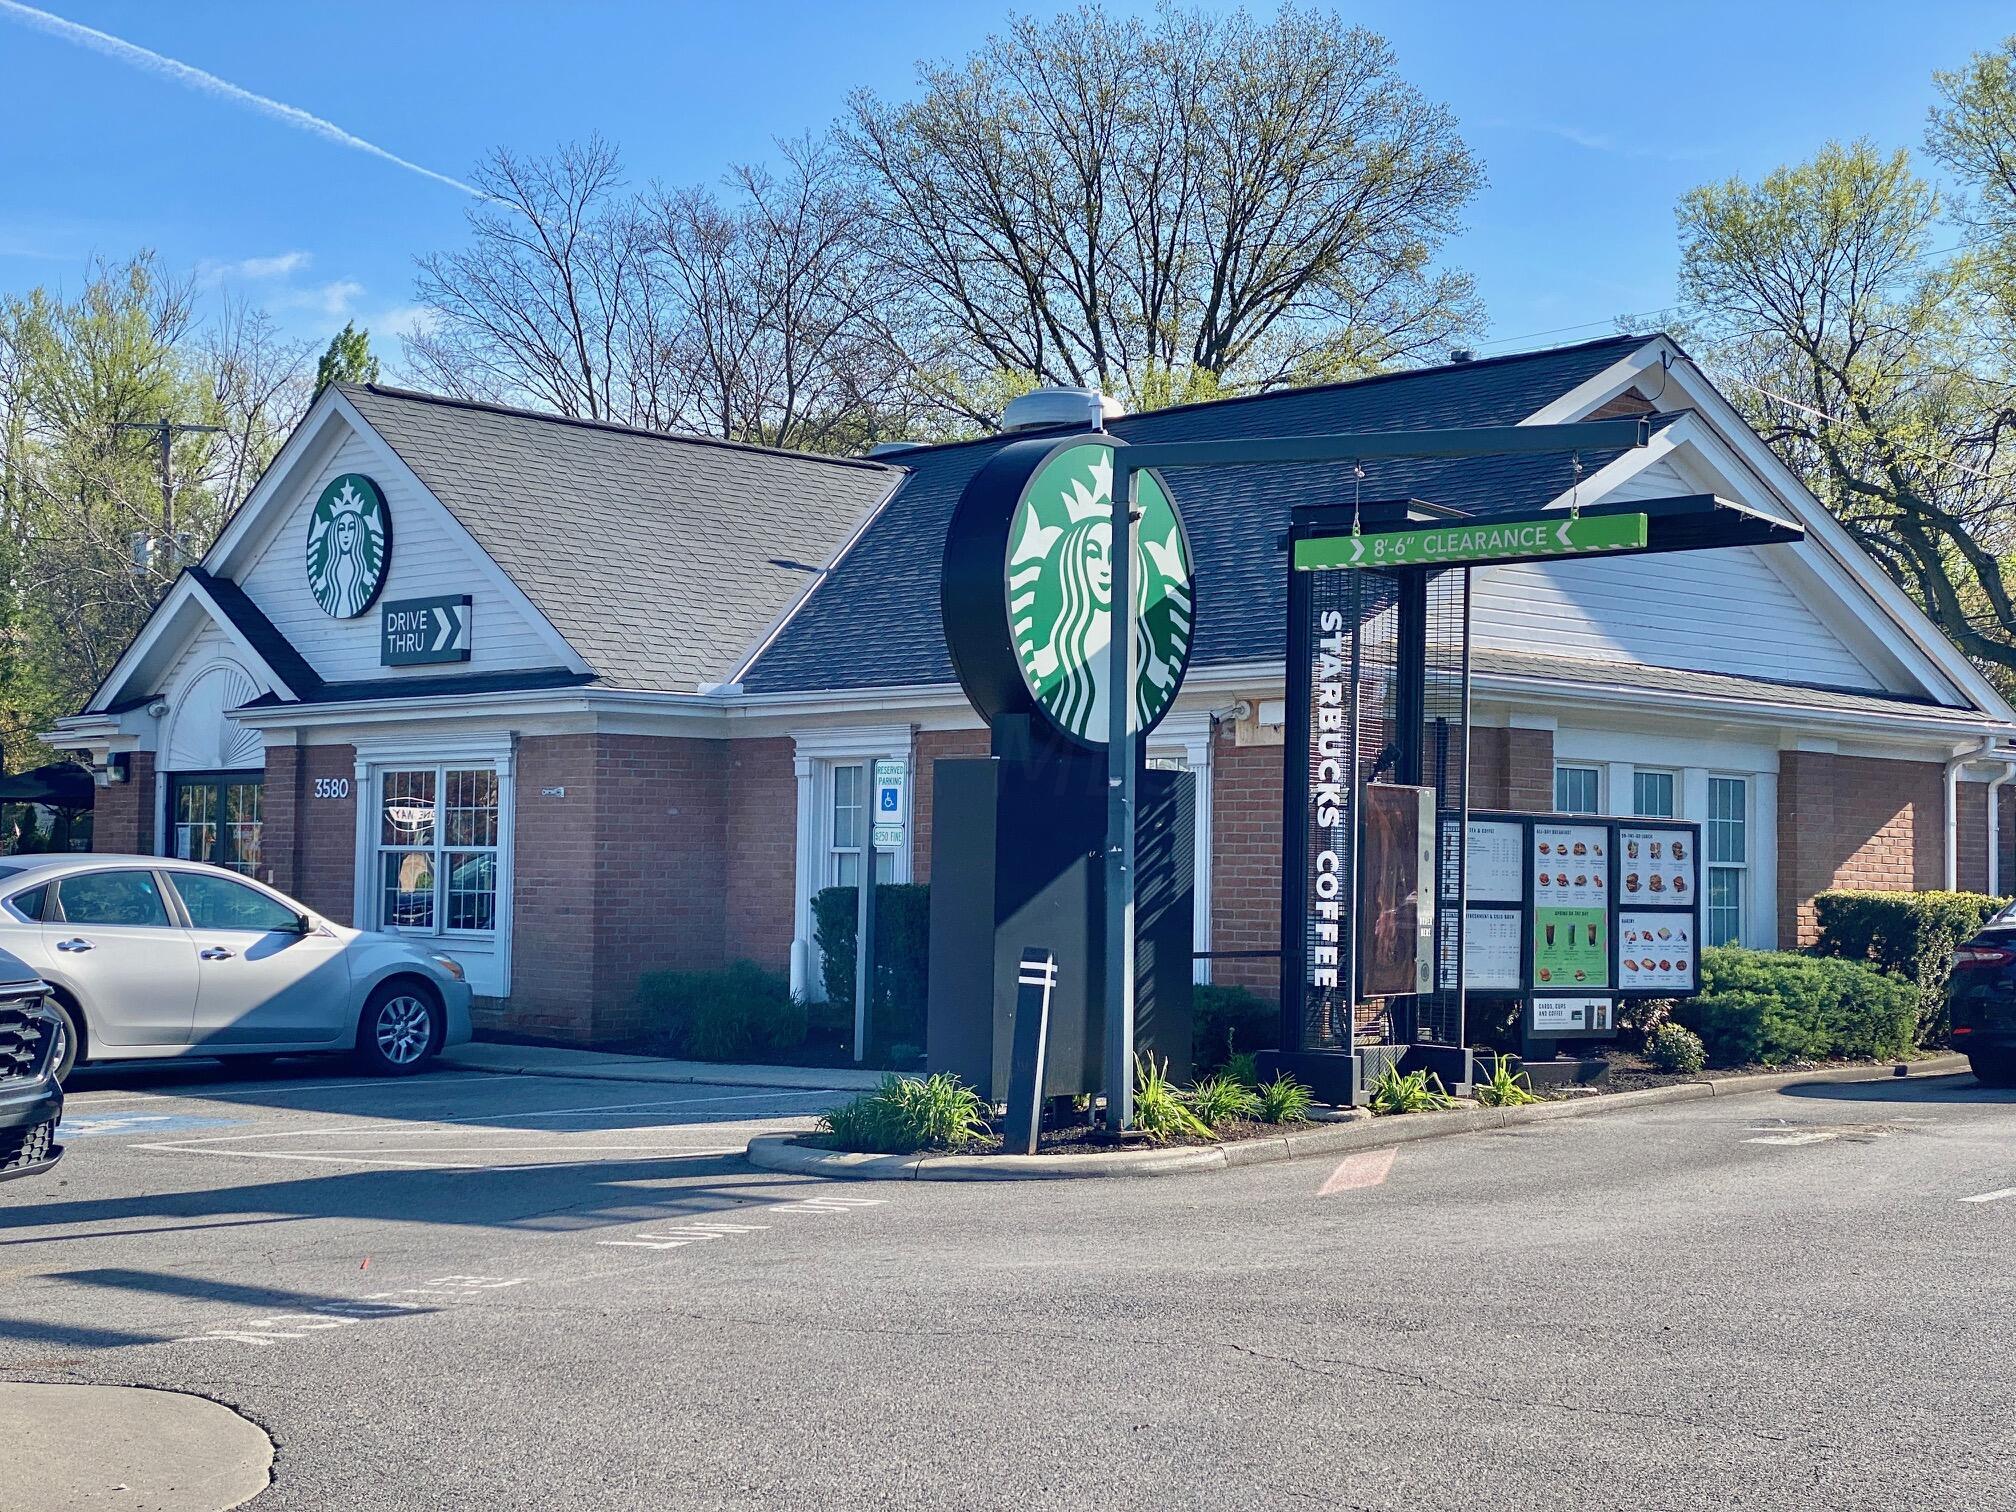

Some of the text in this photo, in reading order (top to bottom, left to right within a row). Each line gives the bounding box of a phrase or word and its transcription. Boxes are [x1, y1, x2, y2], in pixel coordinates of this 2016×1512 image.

[1423, 527, 1548, 555] CLEARANCE
[387, 609, 428, 633] DRIVE
[387, 633, 425, 654] THRU
[877, 765, 904, 775] RESERVED
[314, 777, 349, 799] 3580
[878, 777, 902, 786] PARKING
[1314, 610, 1343, 988] STARBUCKS COFFEE
[875, 831, 903, 842] $250 FINE
[766, 1196, 892, 1215] DO
[595, 1222, 774, 1250] NOT
